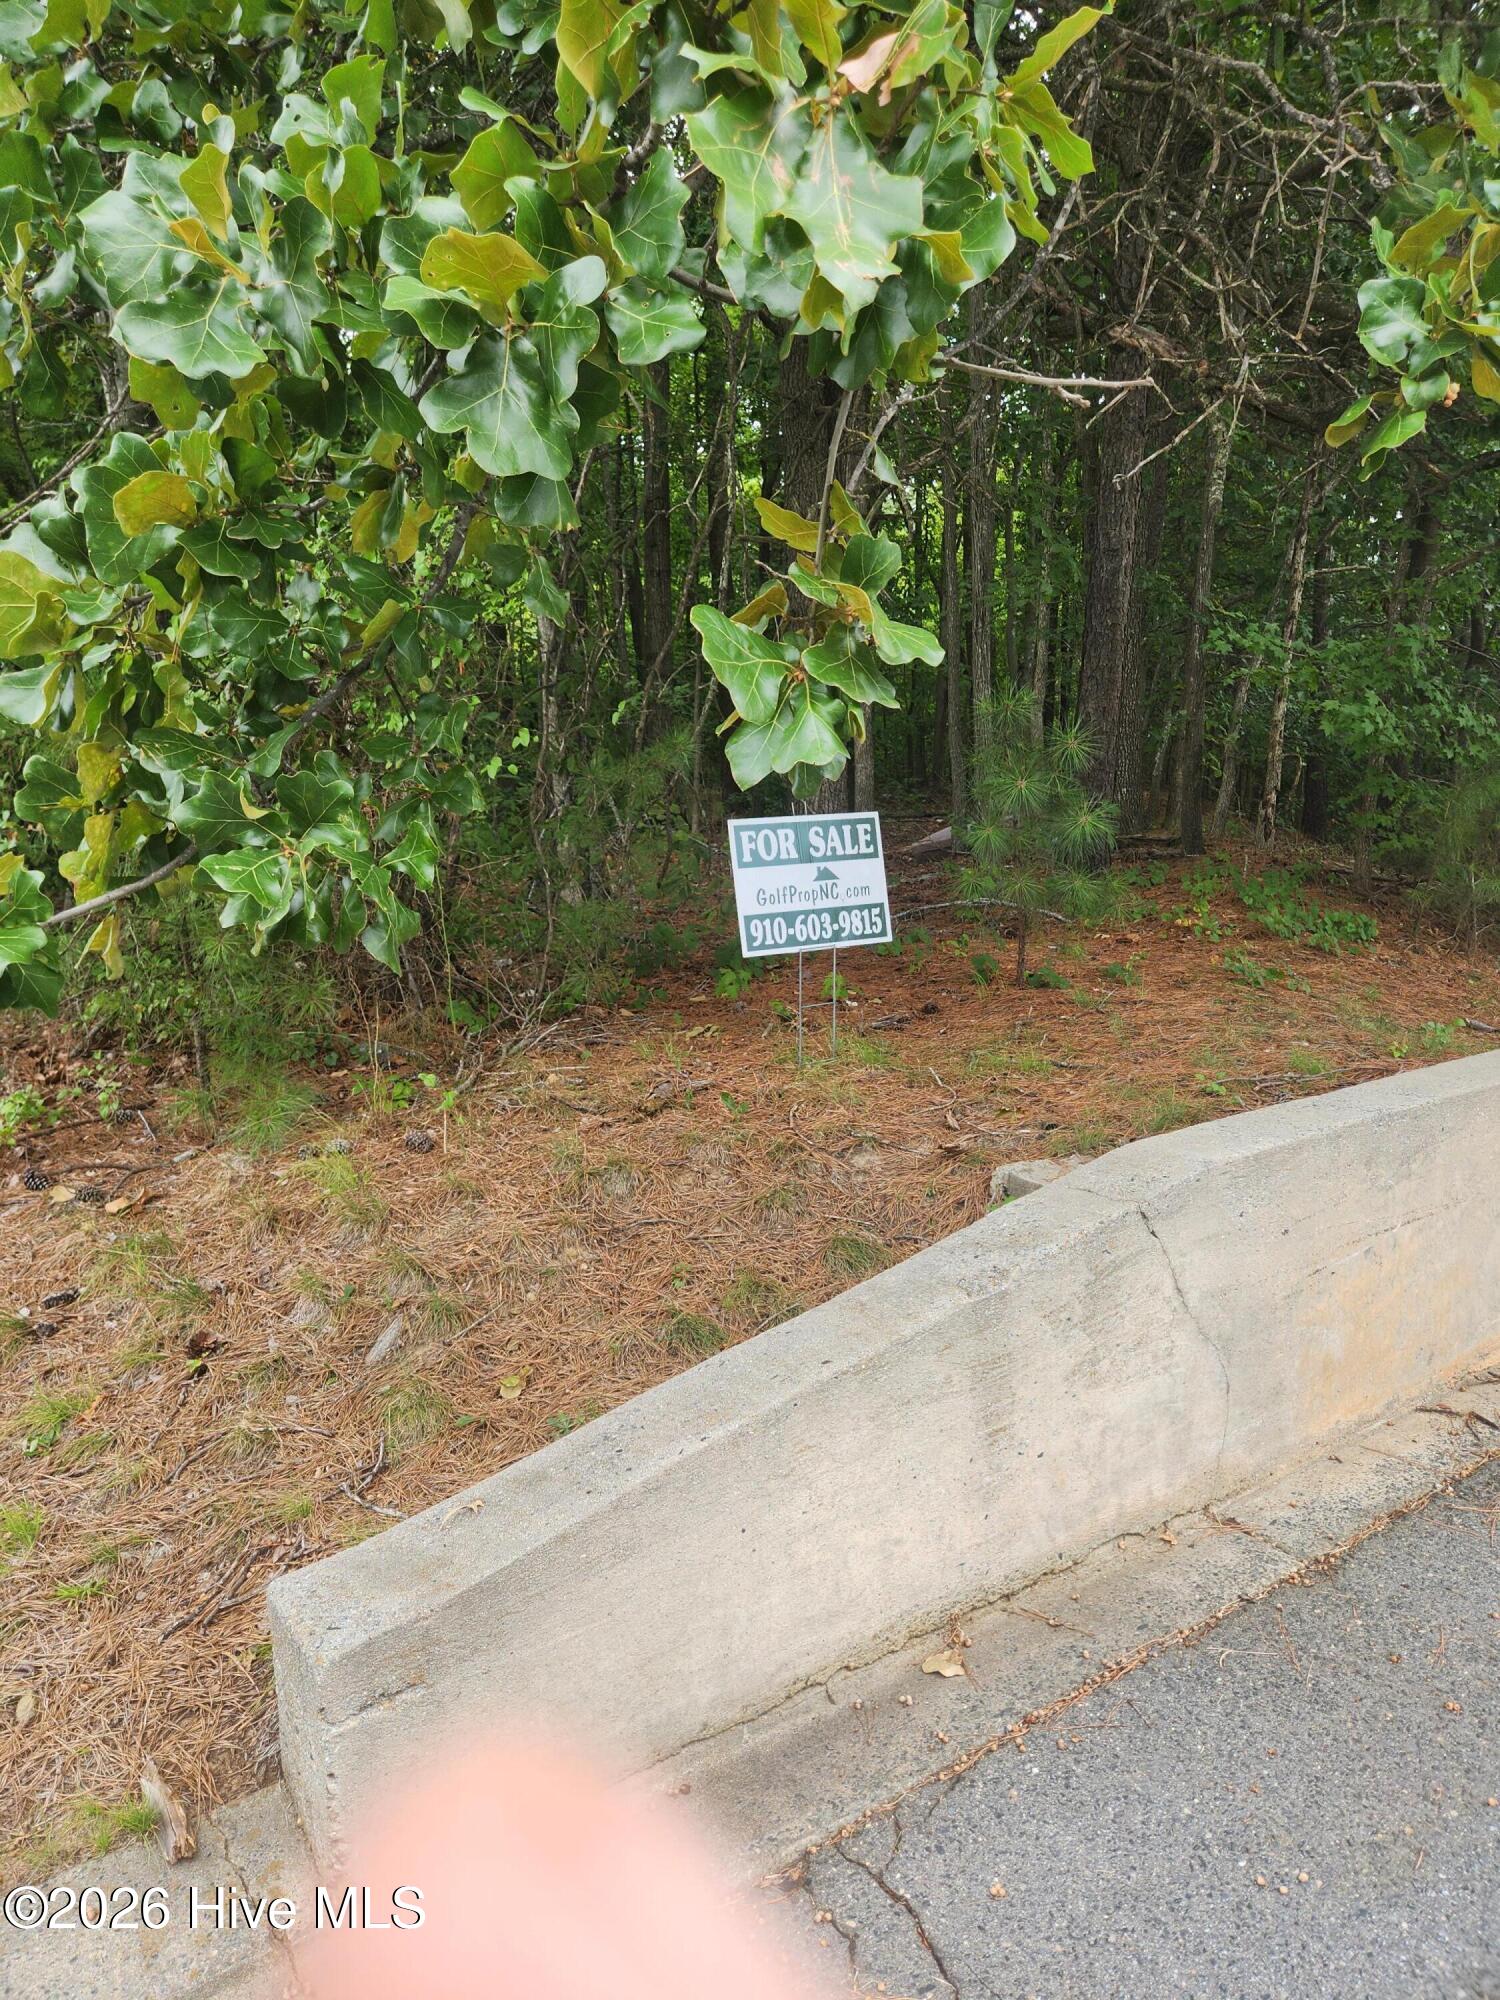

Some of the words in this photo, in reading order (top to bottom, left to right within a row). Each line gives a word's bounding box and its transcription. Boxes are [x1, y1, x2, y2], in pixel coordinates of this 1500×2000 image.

[740, 828, 798, 862] FOR
[809, 823, 874, 858] SALE
[756, 882, 870, 906] GolfPropNC.com
[750, 907, 882, 947] 910-603-9815
